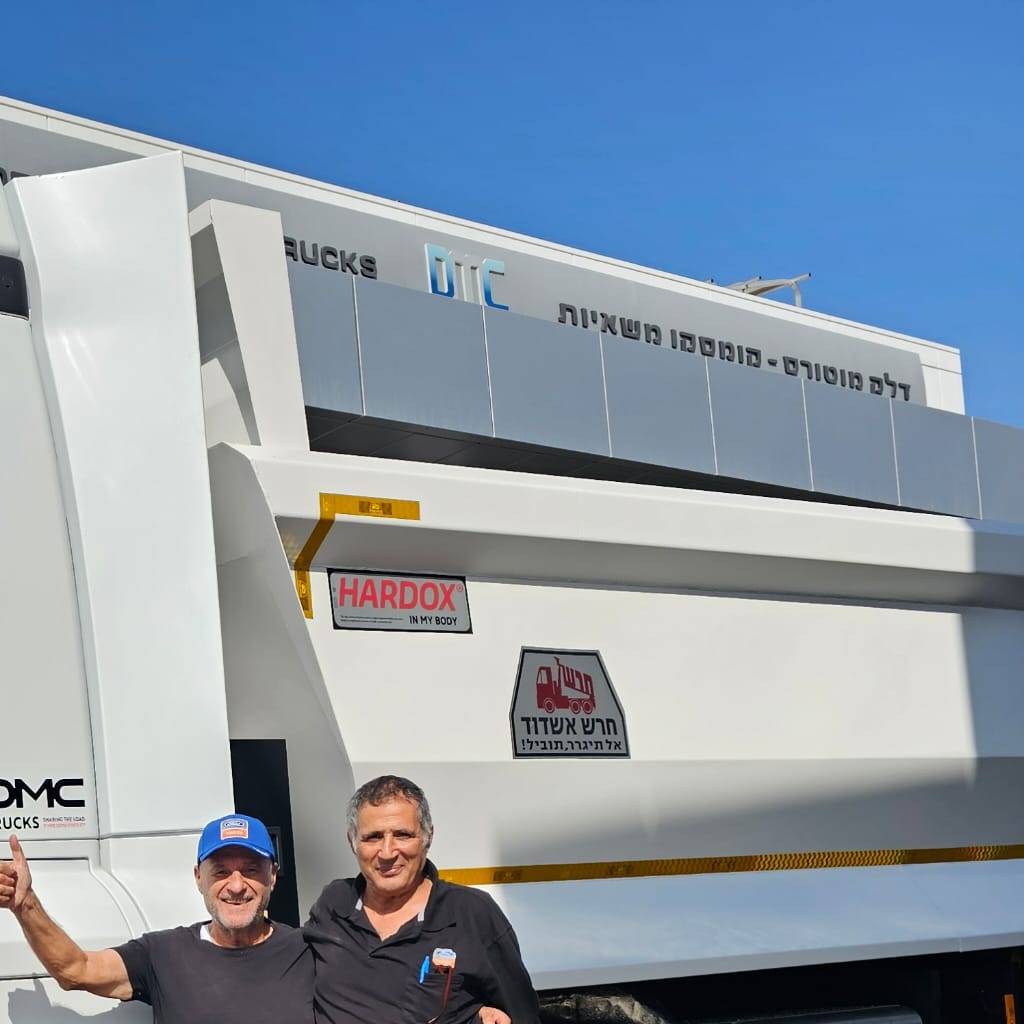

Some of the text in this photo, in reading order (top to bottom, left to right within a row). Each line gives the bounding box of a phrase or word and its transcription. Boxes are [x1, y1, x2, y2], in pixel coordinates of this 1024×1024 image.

[557, 302, 662, 346] משאיות
[670, 328, 762, 369] קומסקו
[783, 355, 864, 391] מוטורס
[869, 372, 911, 401] דלק
[409, 615, 418, 625] IN
[420, 616, 433, 625] MY
[435, 616, 458, 626] BODY
[521, 717, 617, 735] חרש אשדוד
